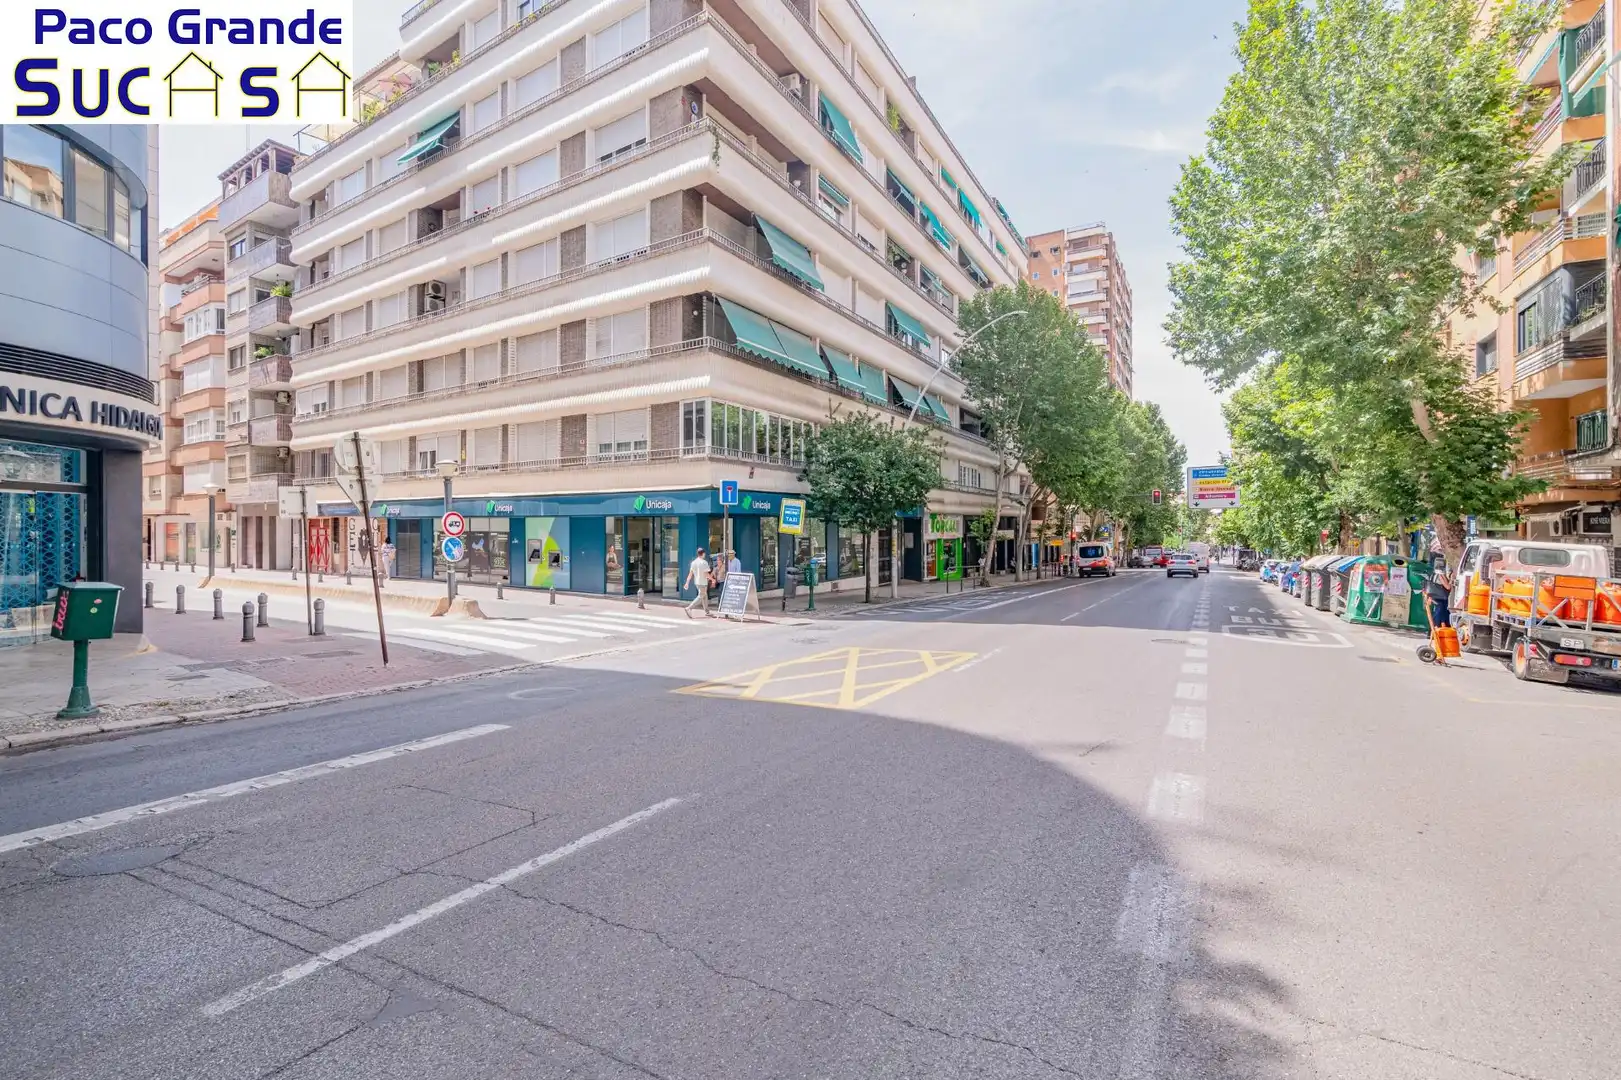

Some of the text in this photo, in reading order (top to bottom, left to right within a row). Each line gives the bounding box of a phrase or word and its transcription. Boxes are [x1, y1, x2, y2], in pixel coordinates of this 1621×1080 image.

[494, 503, 513, 514] Unicaja
[645, 499, 672, 511] Unicaja
[752, 500, 771, 511] Unicaja
